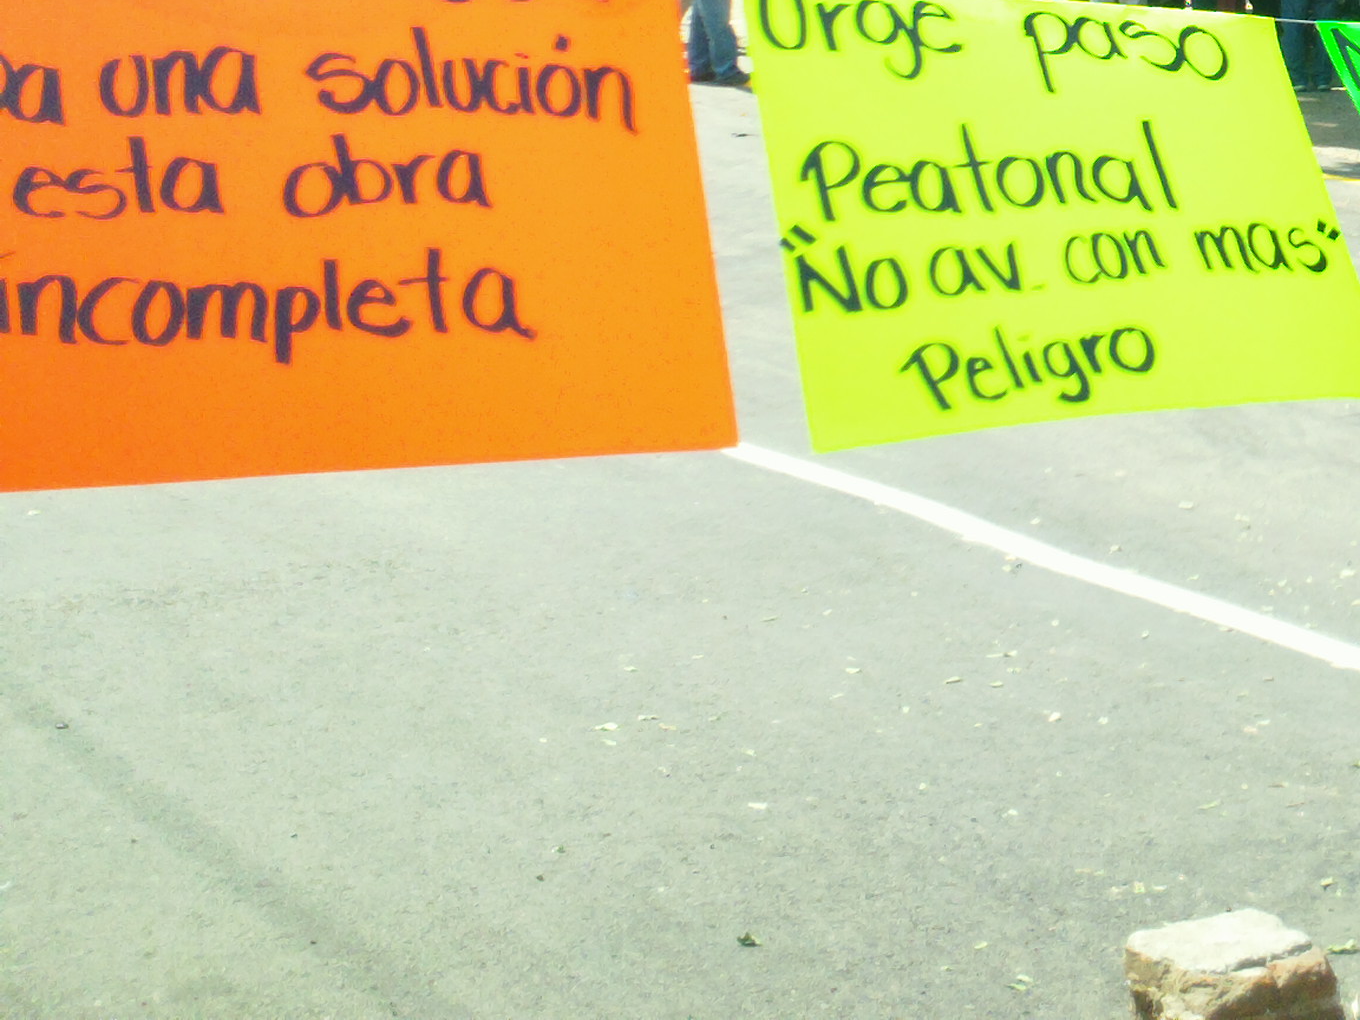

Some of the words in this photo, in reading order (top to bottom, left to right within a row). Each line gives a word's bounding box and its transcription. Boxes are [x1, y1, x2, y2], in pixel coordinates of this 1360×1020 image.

[99, 46, 262, 118] una
[306, 26, 639, 135] solución
[1024, 10, 1229, 92] paso
[13, 136, 225, 219] esta
[282, 134, 494, 218] obra
[800, 121, 1177, 221] Peatonal
[1064, 228, 1166, 283] con
[901, 325, 1156, 410] Peligro
